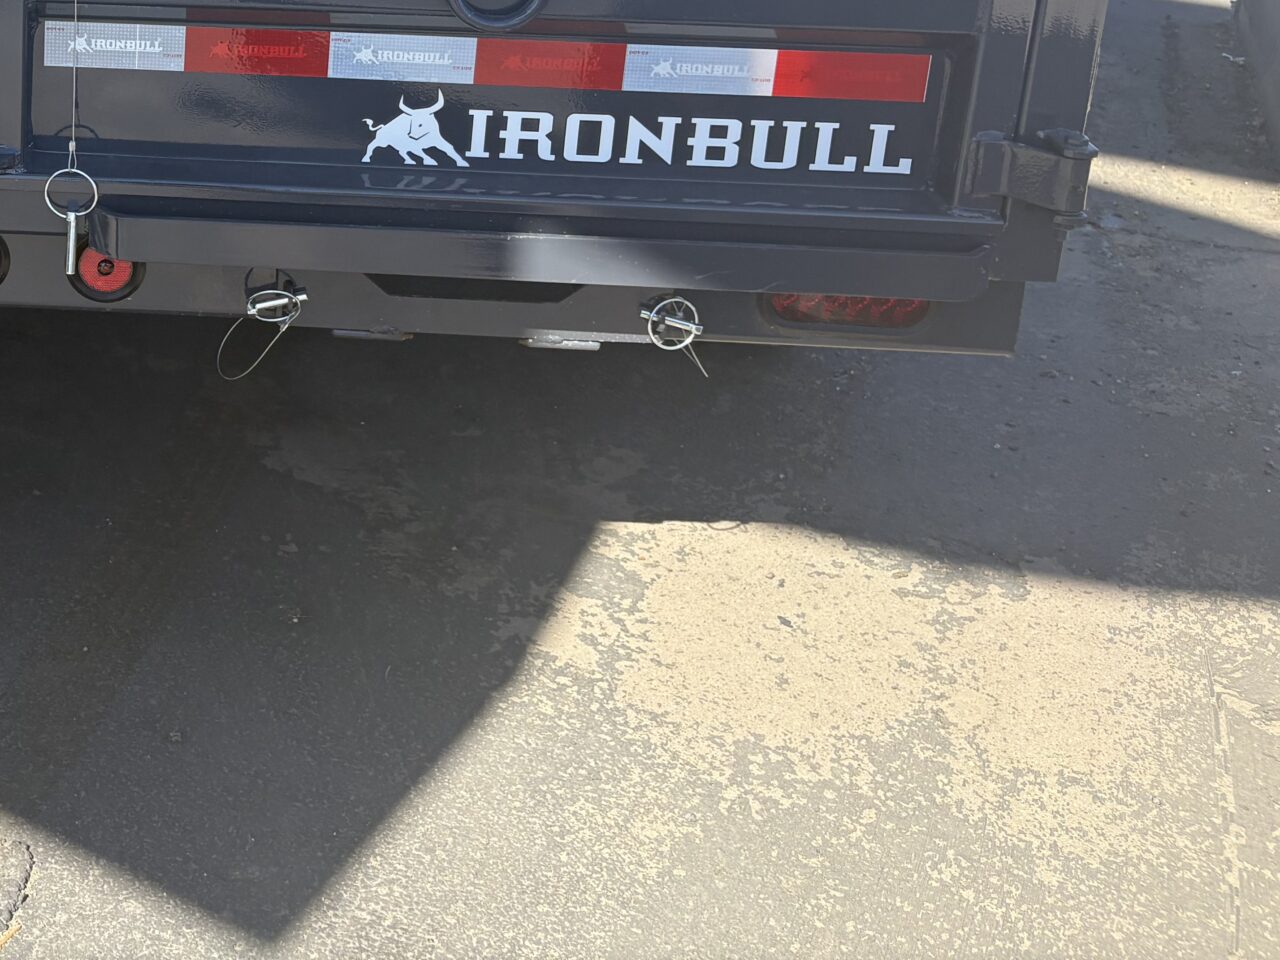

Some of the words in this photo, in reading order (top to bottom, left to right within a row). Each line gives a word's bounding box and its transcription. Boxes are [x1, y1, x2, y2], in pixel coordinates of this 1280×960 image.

[91, 38, 163, 52] IRONBULL
[377, 50, 452, 65] IRONBULL
[676, 63, 751, 78] IRONBULL
[465, 108, 913, 175] IRONBULL
